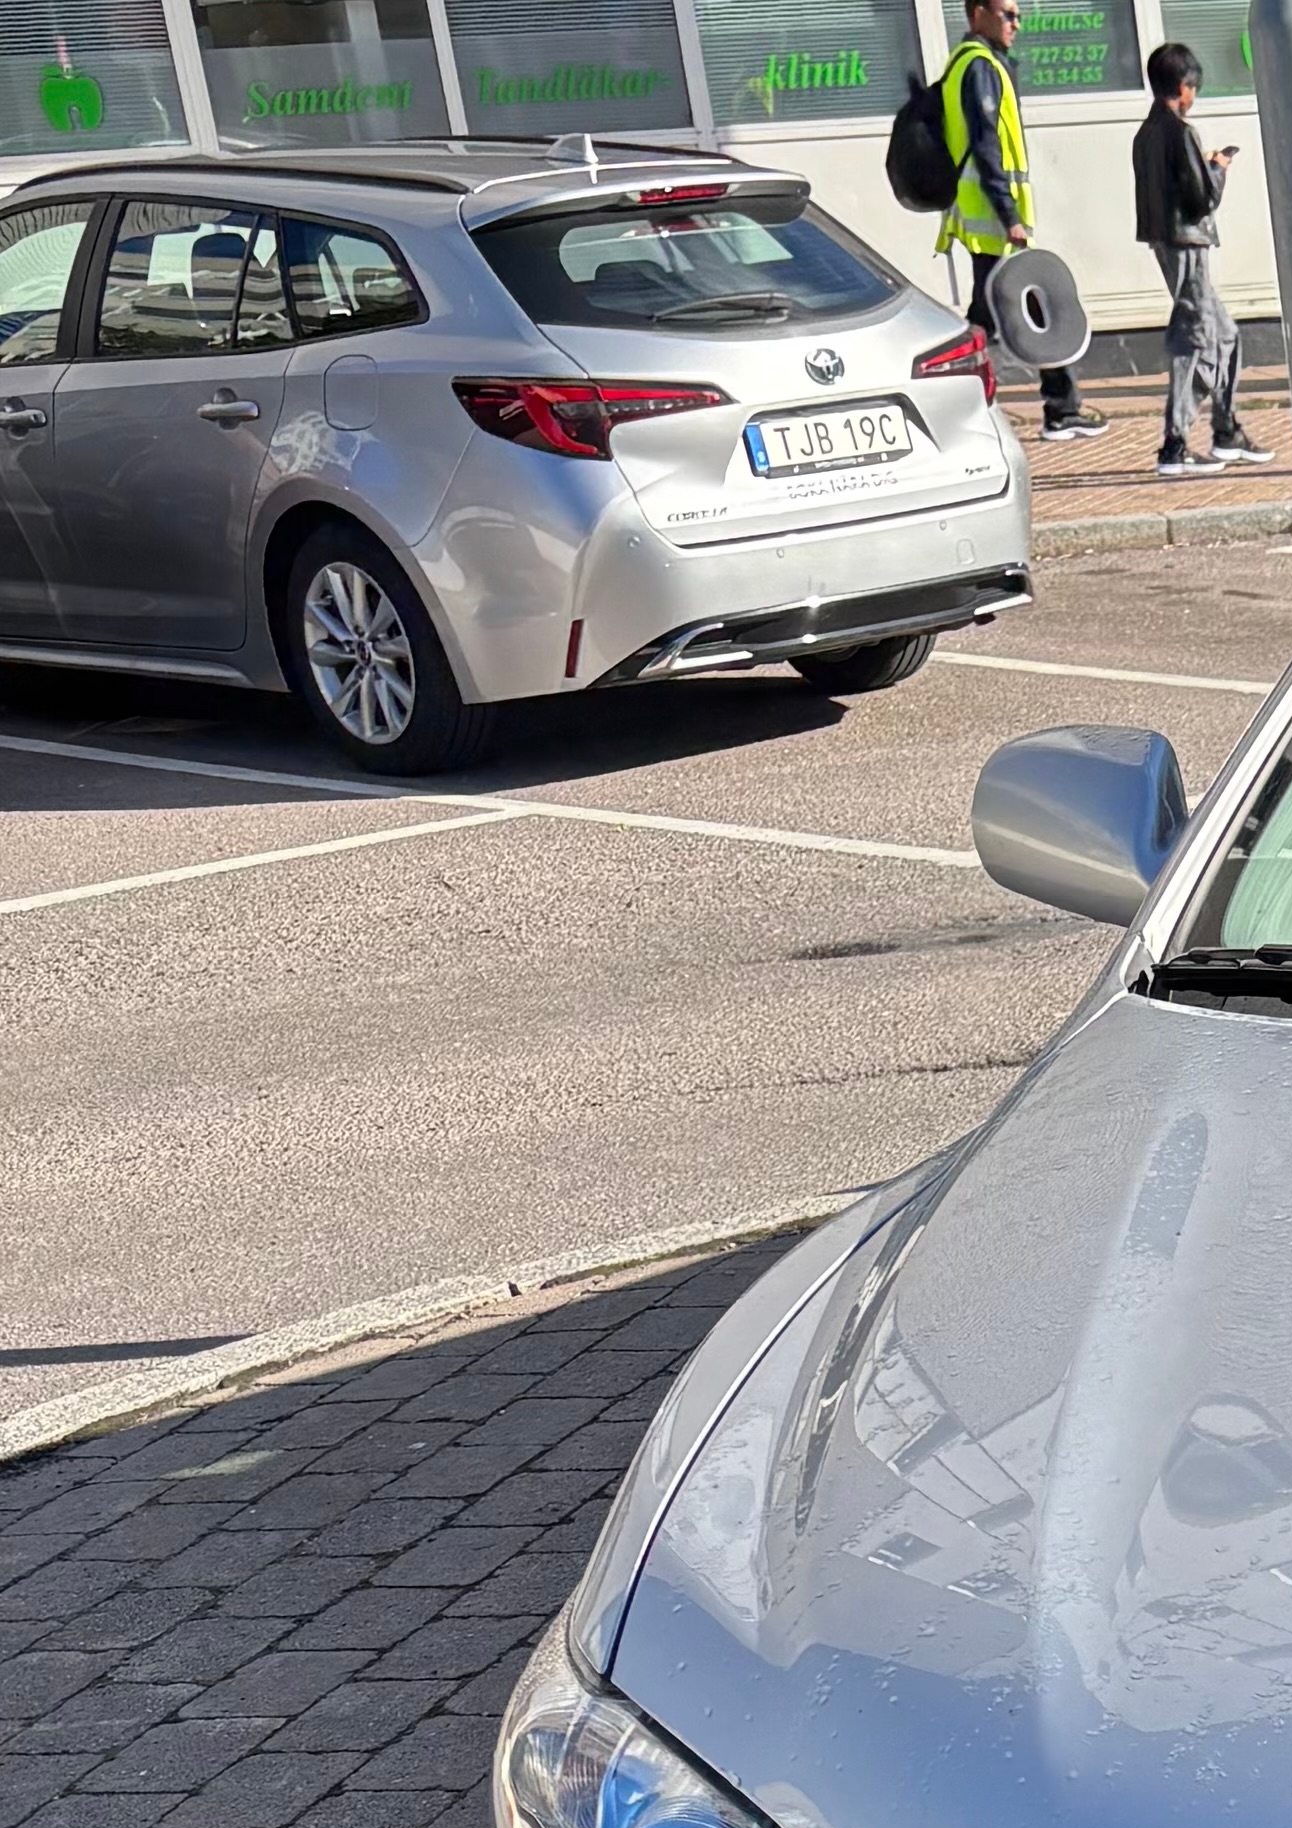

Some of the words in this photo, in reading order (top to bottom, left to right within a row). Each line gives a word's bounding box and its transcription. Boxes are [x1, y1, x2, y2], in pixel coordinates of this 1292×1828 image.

[247, 77, 413, 119] Samdent
[764, 49, 871, 92] klinik
[773, 421, 834, 461] TJB
[843, 413, 896, 451] 19C
